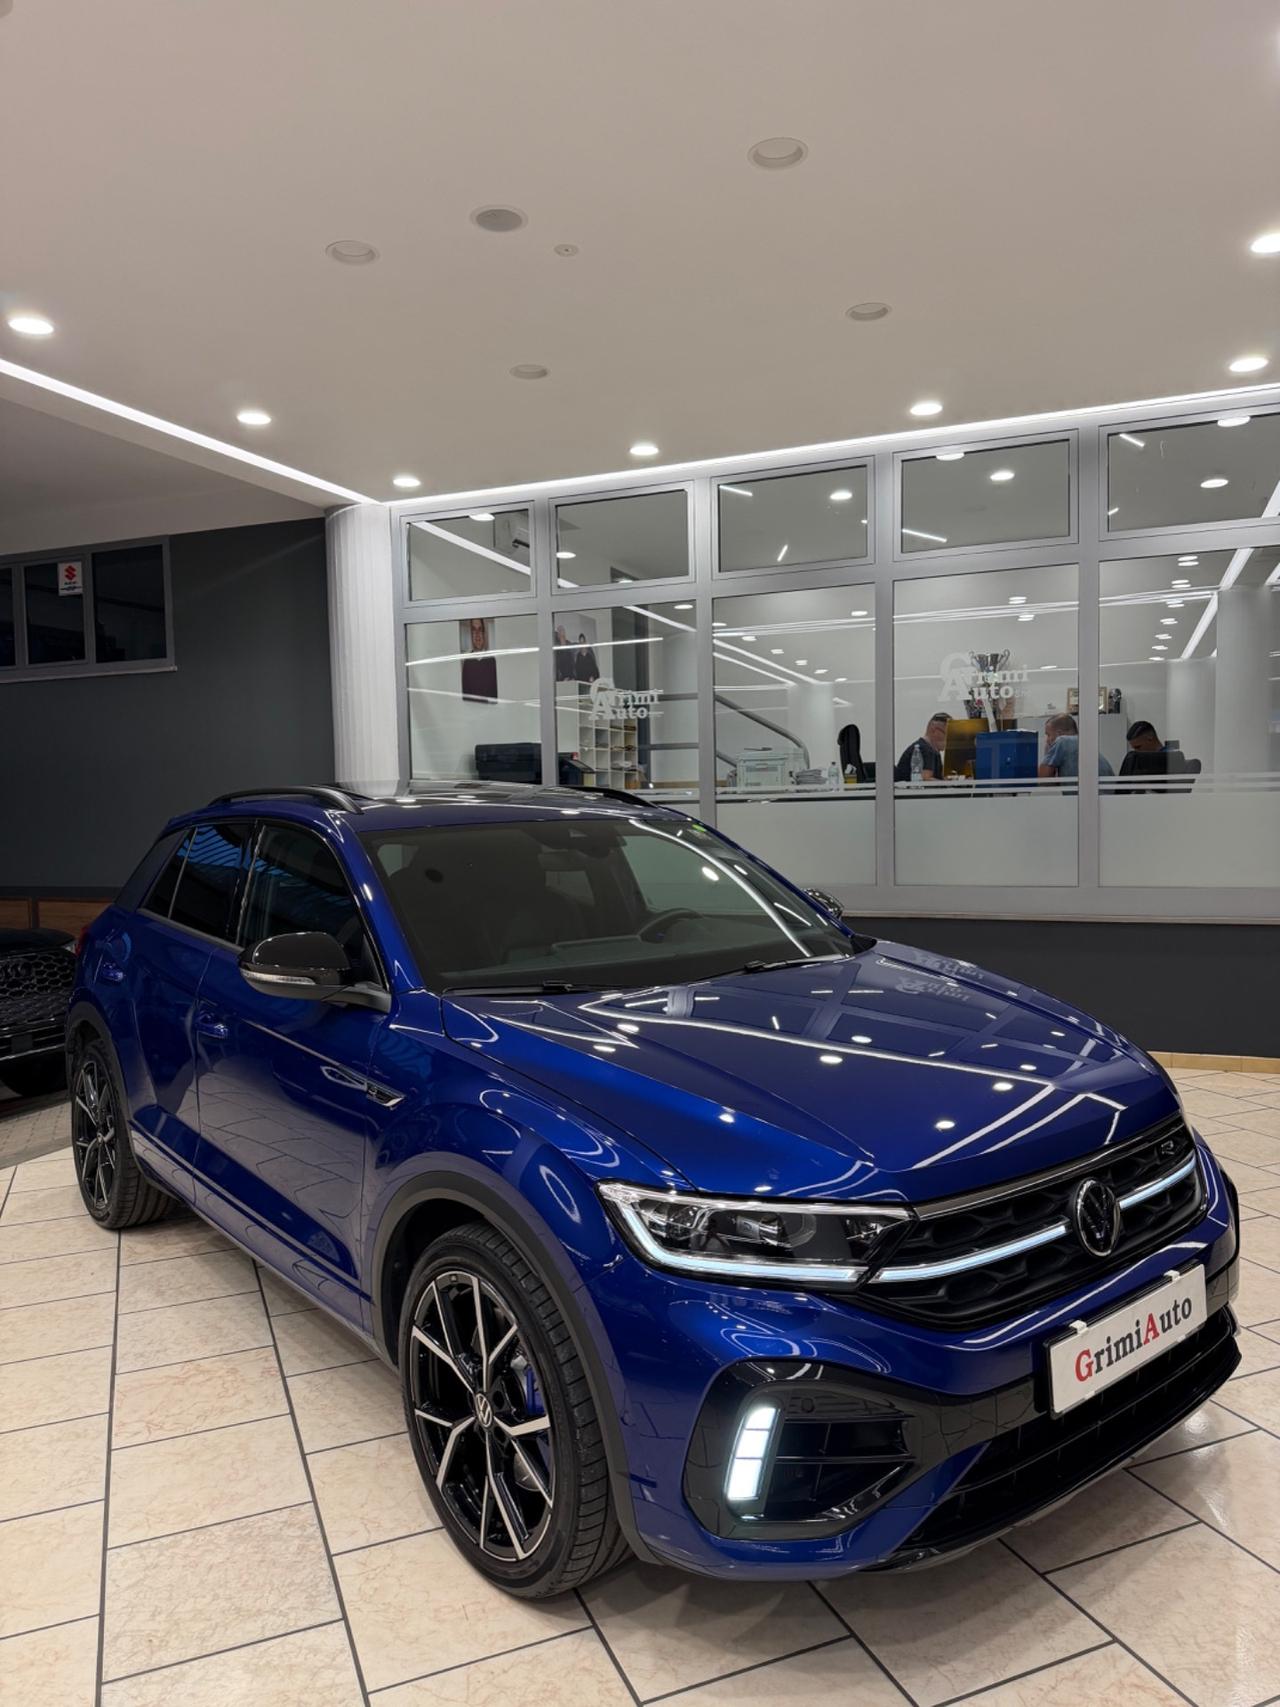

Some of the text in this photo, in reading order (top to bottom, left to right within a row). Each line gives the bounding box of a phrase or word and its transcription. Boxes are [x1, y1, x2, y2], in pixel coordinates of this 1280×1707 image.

[590, 677, 660, 706] Grimi
[937, 667, 1014, 702] Auto
[588, 691, 648, 720] Auto
[1074, 1297, 1192, 1382] GrimiAuto
